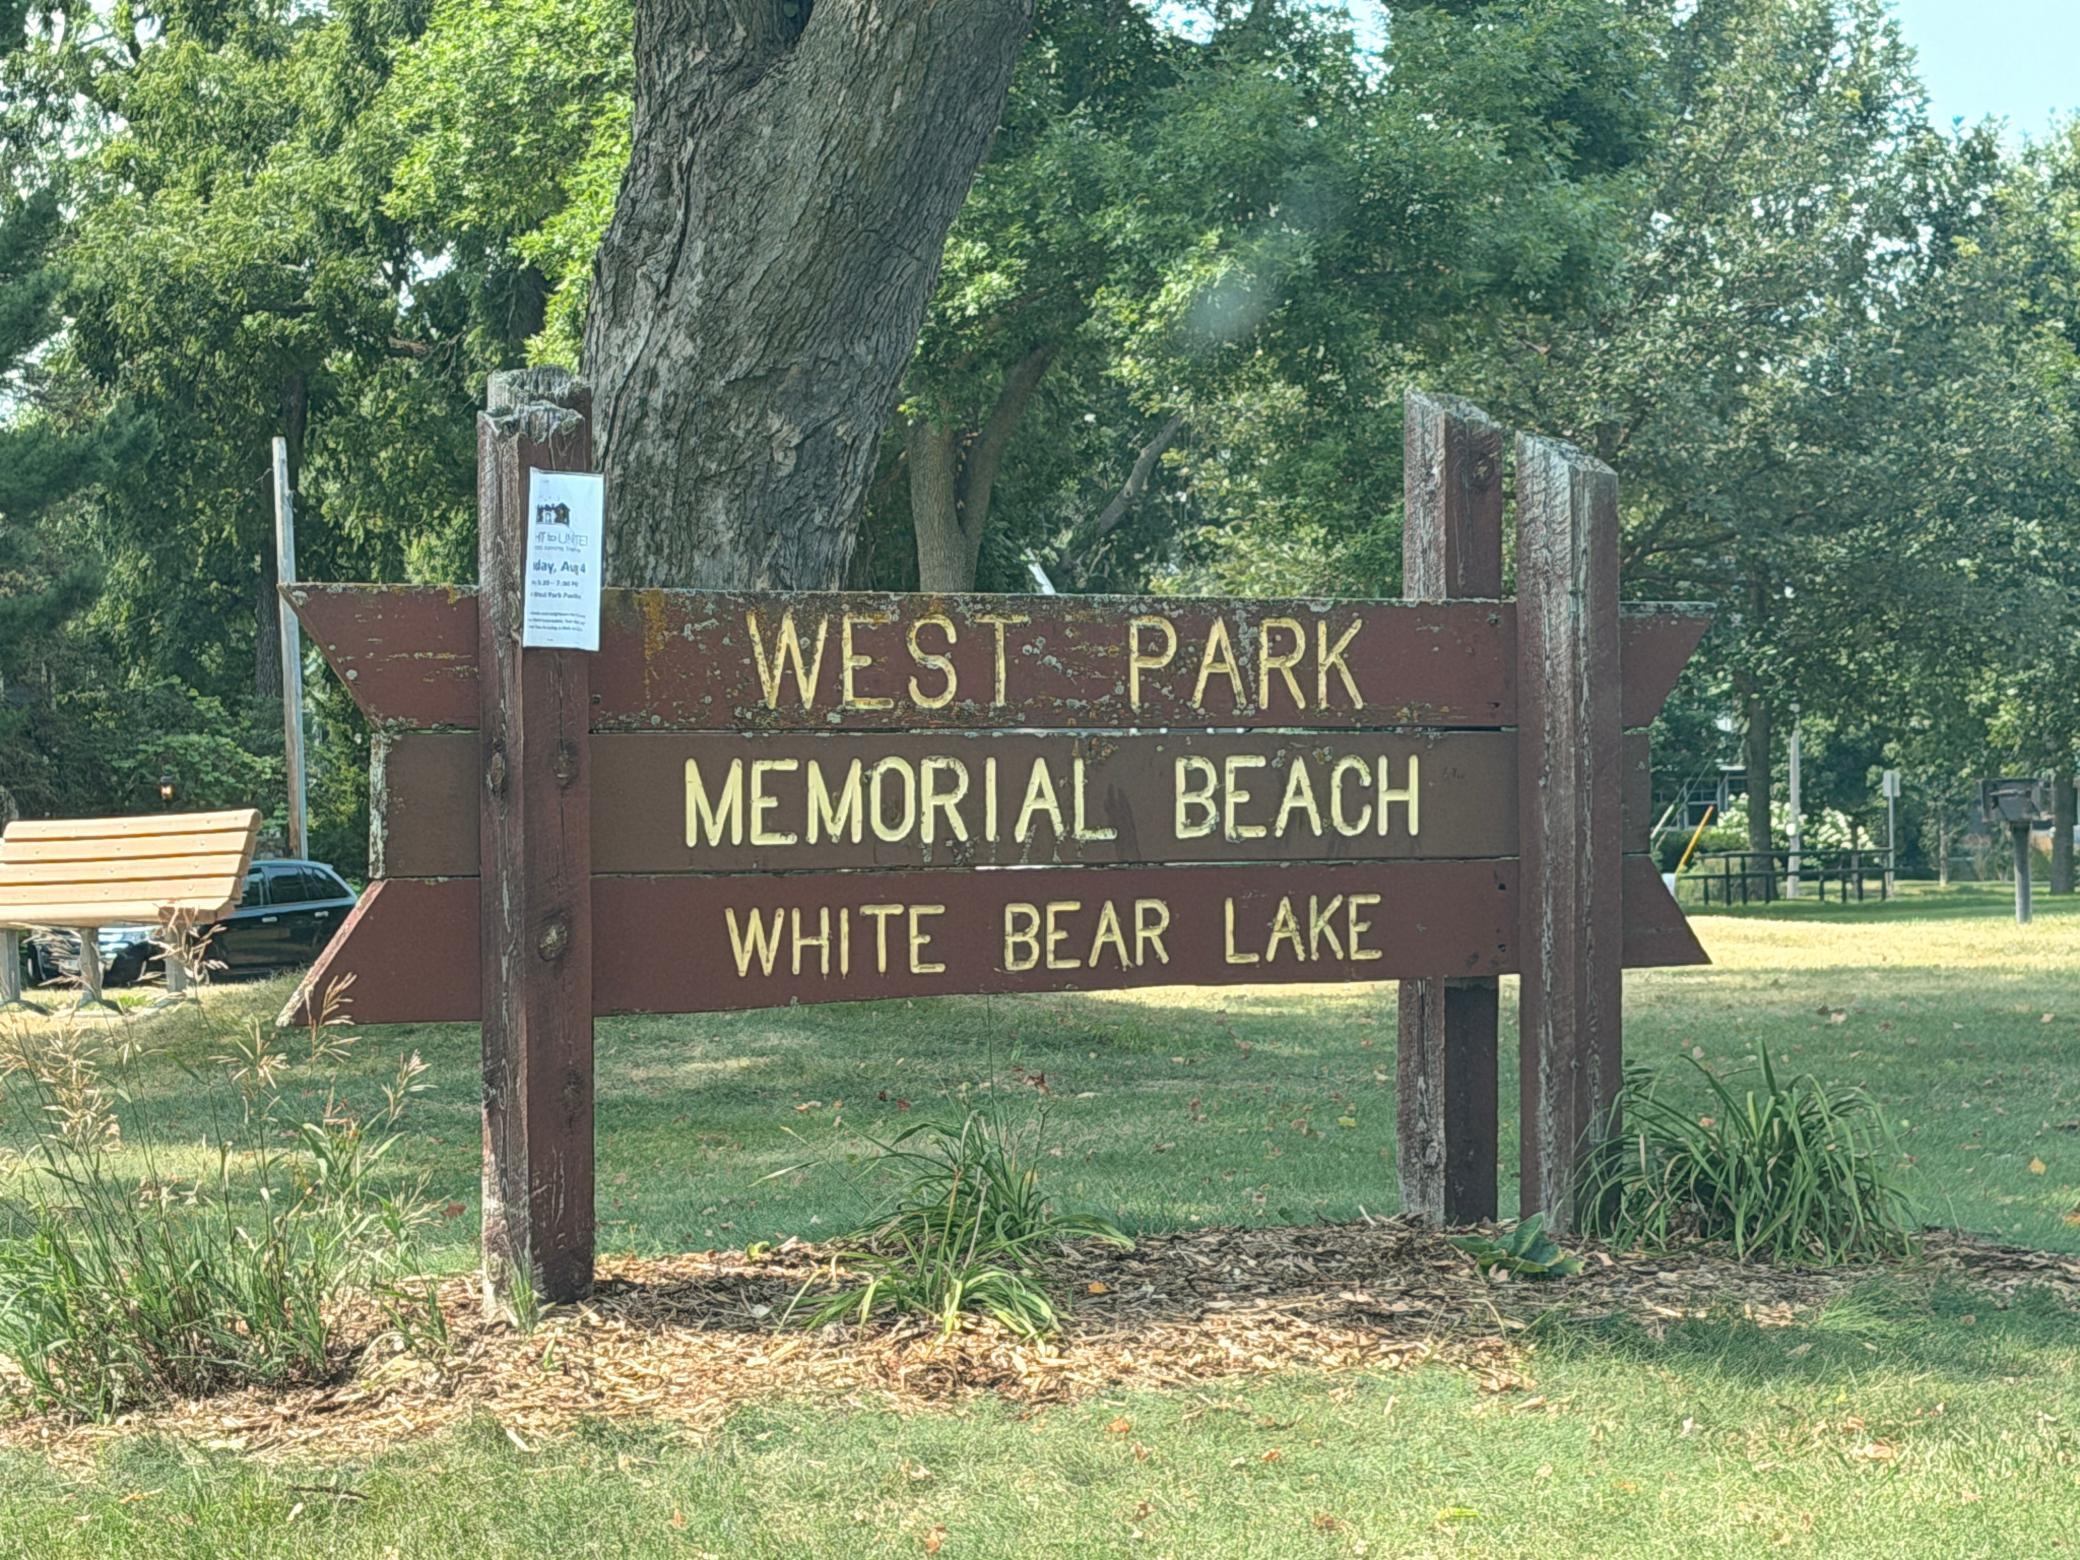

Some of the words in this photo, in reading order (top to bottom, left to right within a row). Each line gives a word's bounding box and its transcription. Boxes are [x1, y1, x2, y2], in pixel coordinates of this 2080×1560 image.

[560, 561, 579, 576] Aug
[747, 611, 1029, 710] WEST
[1128, 614, 1364, 711] PARK
[684, 755, 1118, 847] MEMORIAL
[1174, 753, 1420, 840] BEACH
[724, 904, 946, 977] WHITE
[1003, 901, 1171, 972] BEAR
[1224, 894, 1383, 965] LAKE
